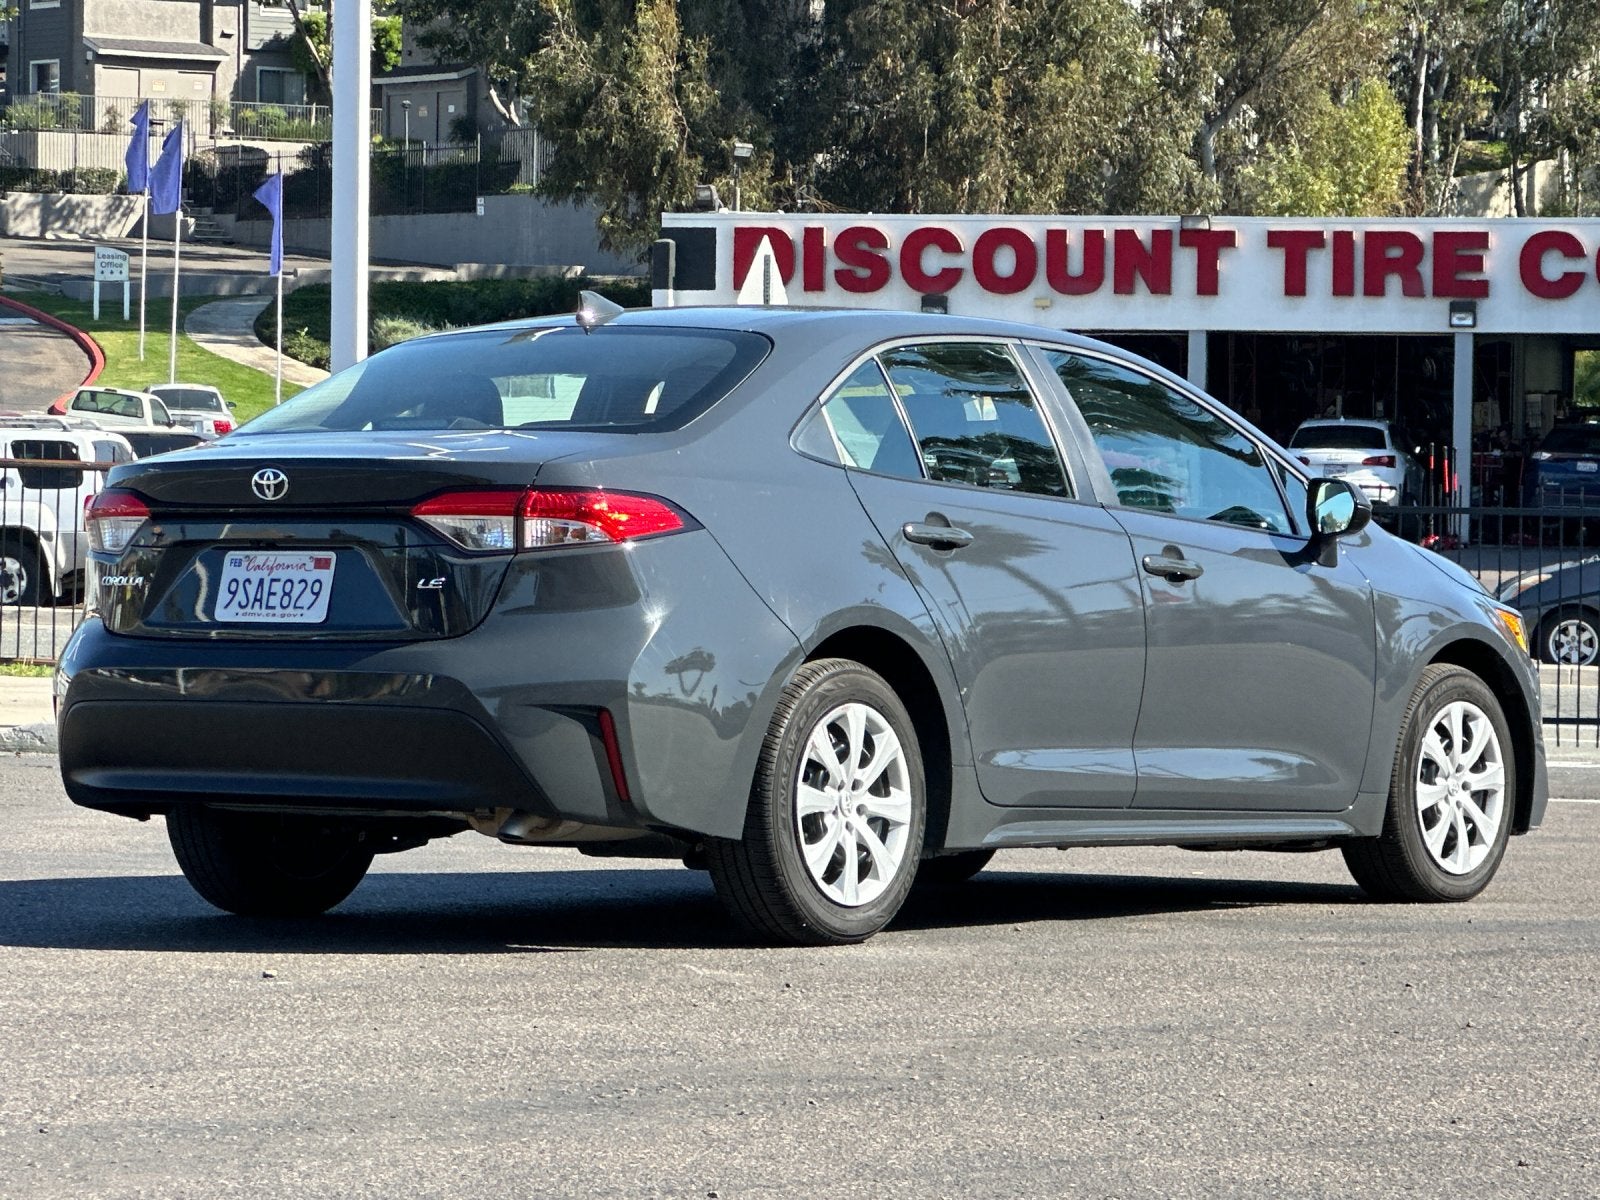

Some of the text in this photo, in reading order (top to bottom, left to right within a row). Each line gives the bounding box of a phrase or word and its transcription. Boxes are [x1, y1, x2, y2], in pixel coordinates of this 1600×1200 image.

[97, 252, 127, 261] Leasing
[734, 226, 1600, 299] DISCOUNT TIRE C
[100, 261, 123, 269] Office
[229, 558, 243, 567] FEB
[245, 555, 313, 576] California
[101, 575, 144, 589] COROLLA
[417, 577, 446, 589] LE
[223, 578, 322, 610] 9SAE829
